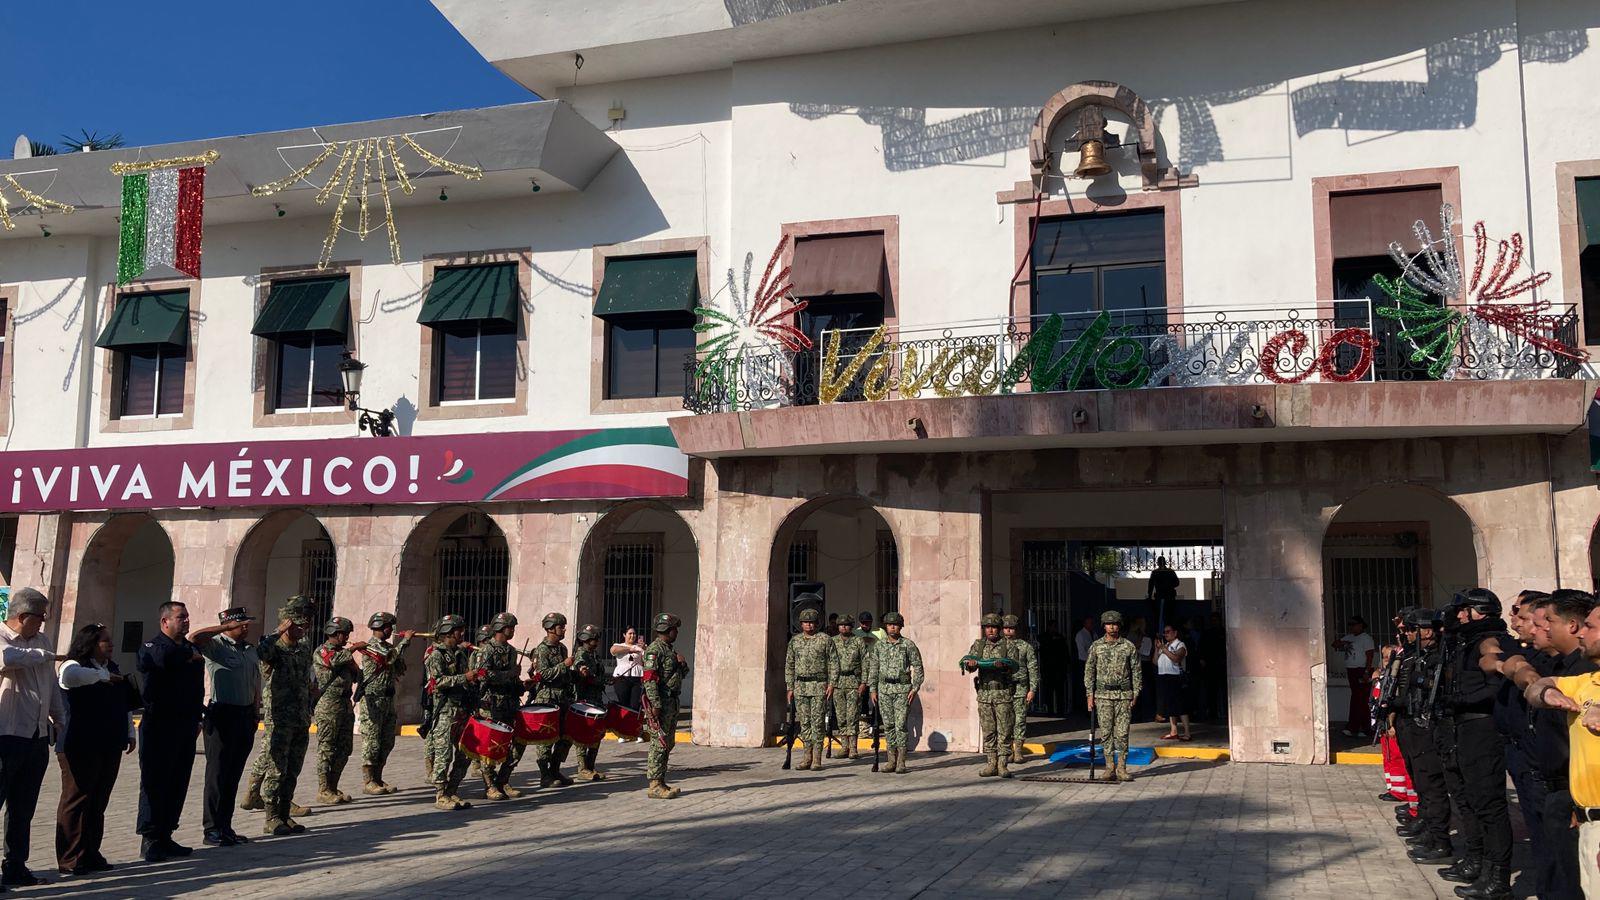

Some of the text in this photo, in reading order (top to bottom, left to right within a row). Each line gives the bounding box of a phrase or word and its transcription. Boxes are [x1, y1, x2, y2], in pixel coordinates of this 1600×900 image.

[819, 309, 1379, 404] Viva México
[11, 447, 420, 504] ¡VIVA MÉXICO!
